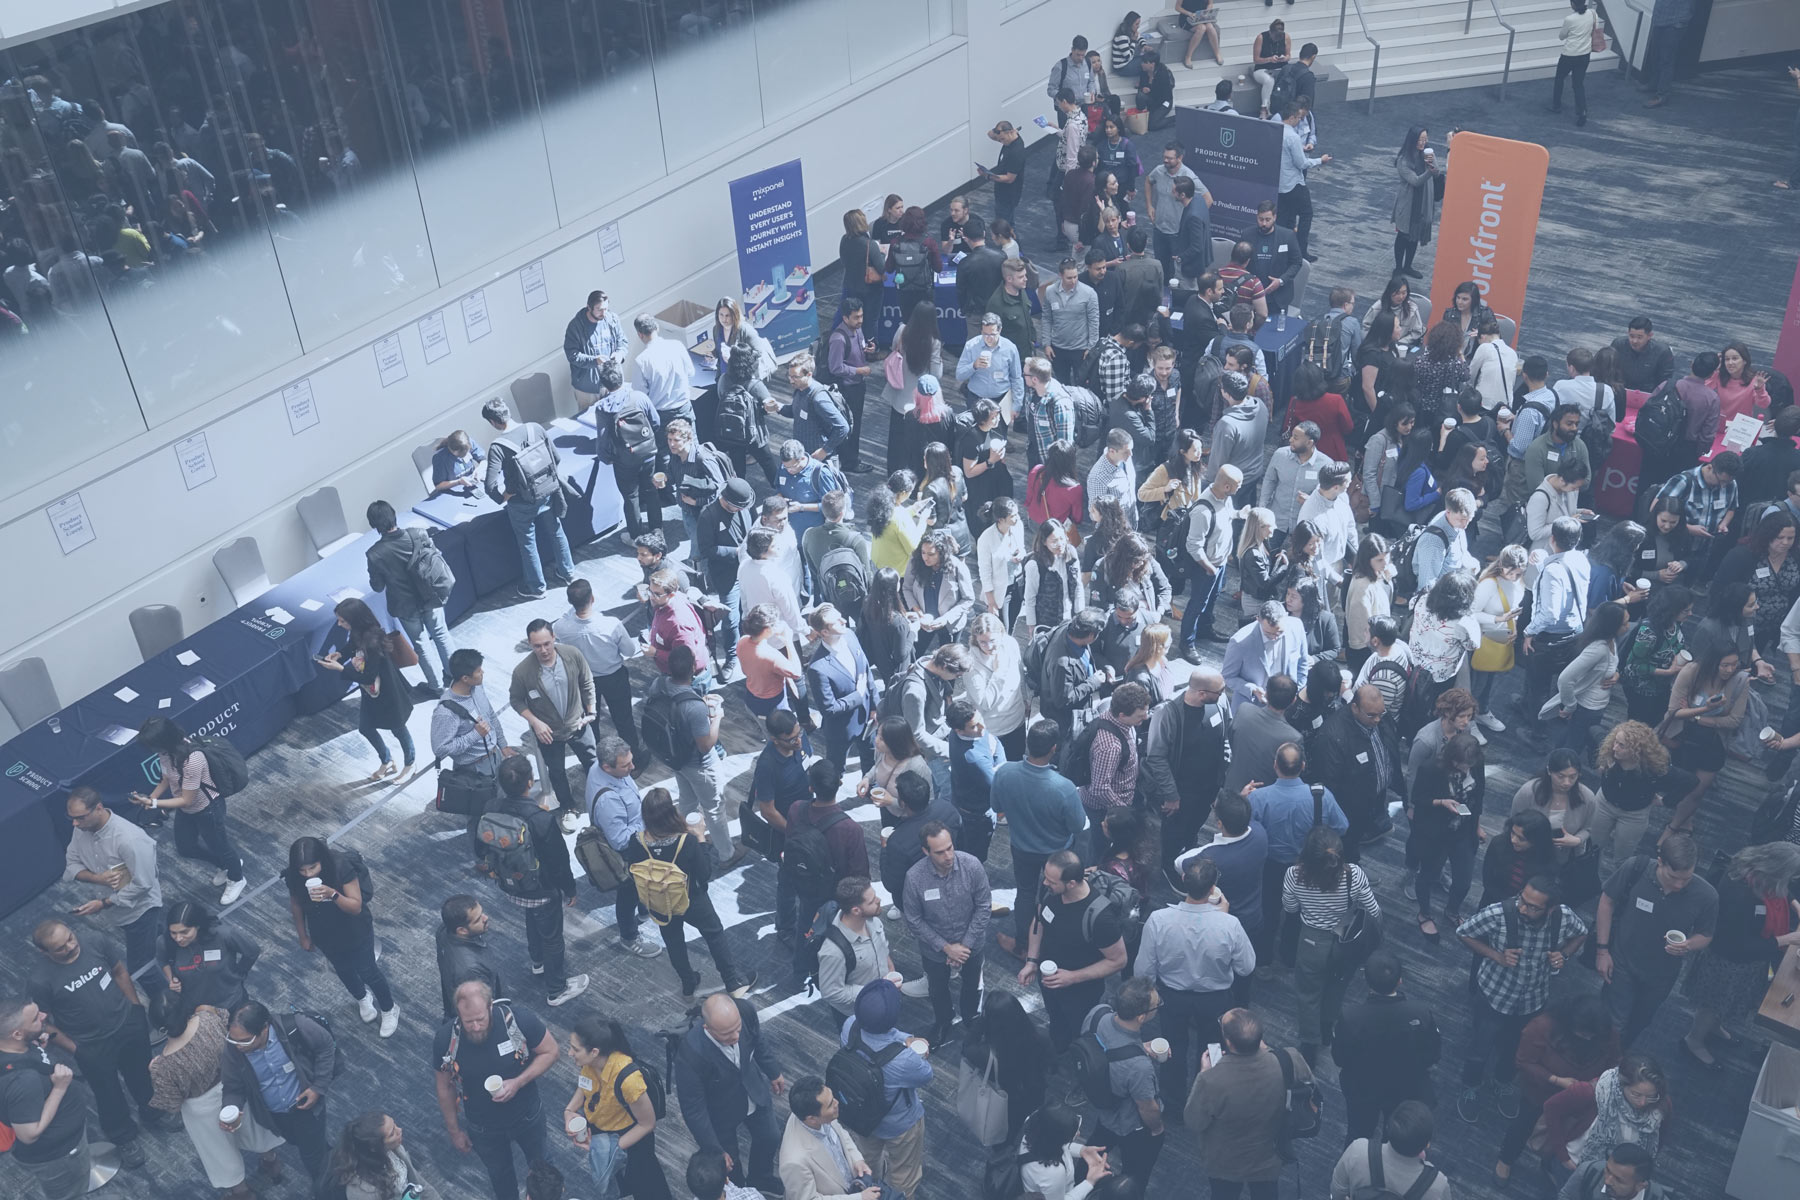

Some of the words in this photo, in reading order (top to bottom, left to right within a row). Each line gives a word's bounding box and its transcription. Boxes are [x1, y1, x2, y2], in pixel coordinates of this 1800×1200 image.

[1194, 147, 1228, 159] PRODUCT
[1230, 154, 1259, 165] SCHOOL
[1205, 158, 1226, 166] SILICON
[752, 178, 785, 197] mixpanel
[748, 200, 793, 221] UNDERSTAND
[1217, 200, 1240, 212] Product
[750, 218, 770, 231] EVERY
[771, 210, 794, 224] USER'S
[749, 226, 779, 243] JOURNEY
[779, 220, 797, 232] WITH
[746, 239, 773, 255] INSTANT
[773, 229, 803, 245] INSIGHTS
[1467, 180, 1506, 307] orkfront
[18, 776, 41, 791] SCHOOL
[26, 770, 53, 787] PRODUCT
